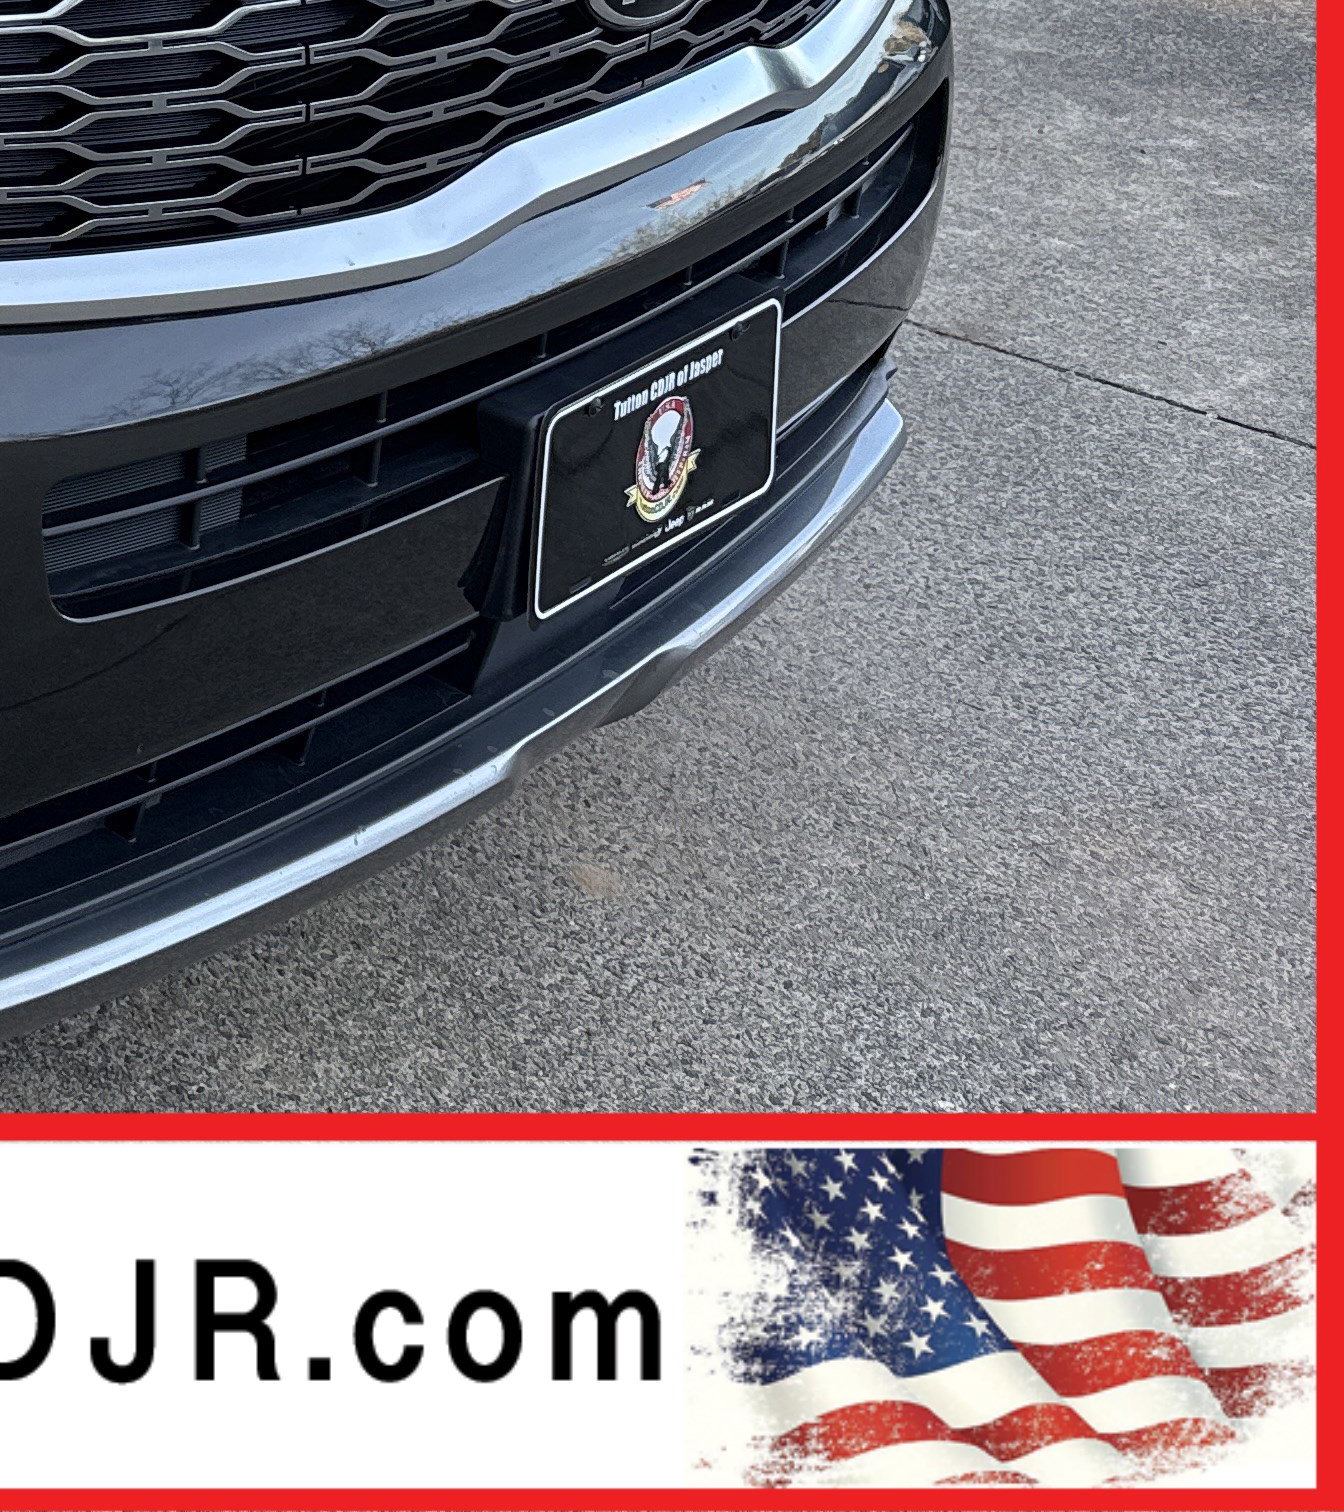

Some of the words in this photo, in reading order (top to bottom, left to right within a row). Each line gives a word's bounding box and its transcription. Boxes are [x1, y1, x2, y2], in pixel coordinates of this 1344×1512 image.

[613, 388, 649, 422] Tutton
[650, 370, 676, 402] CDJR
[676, 364, 689, 387] of
[688, 348, 724, 381] Jasper
